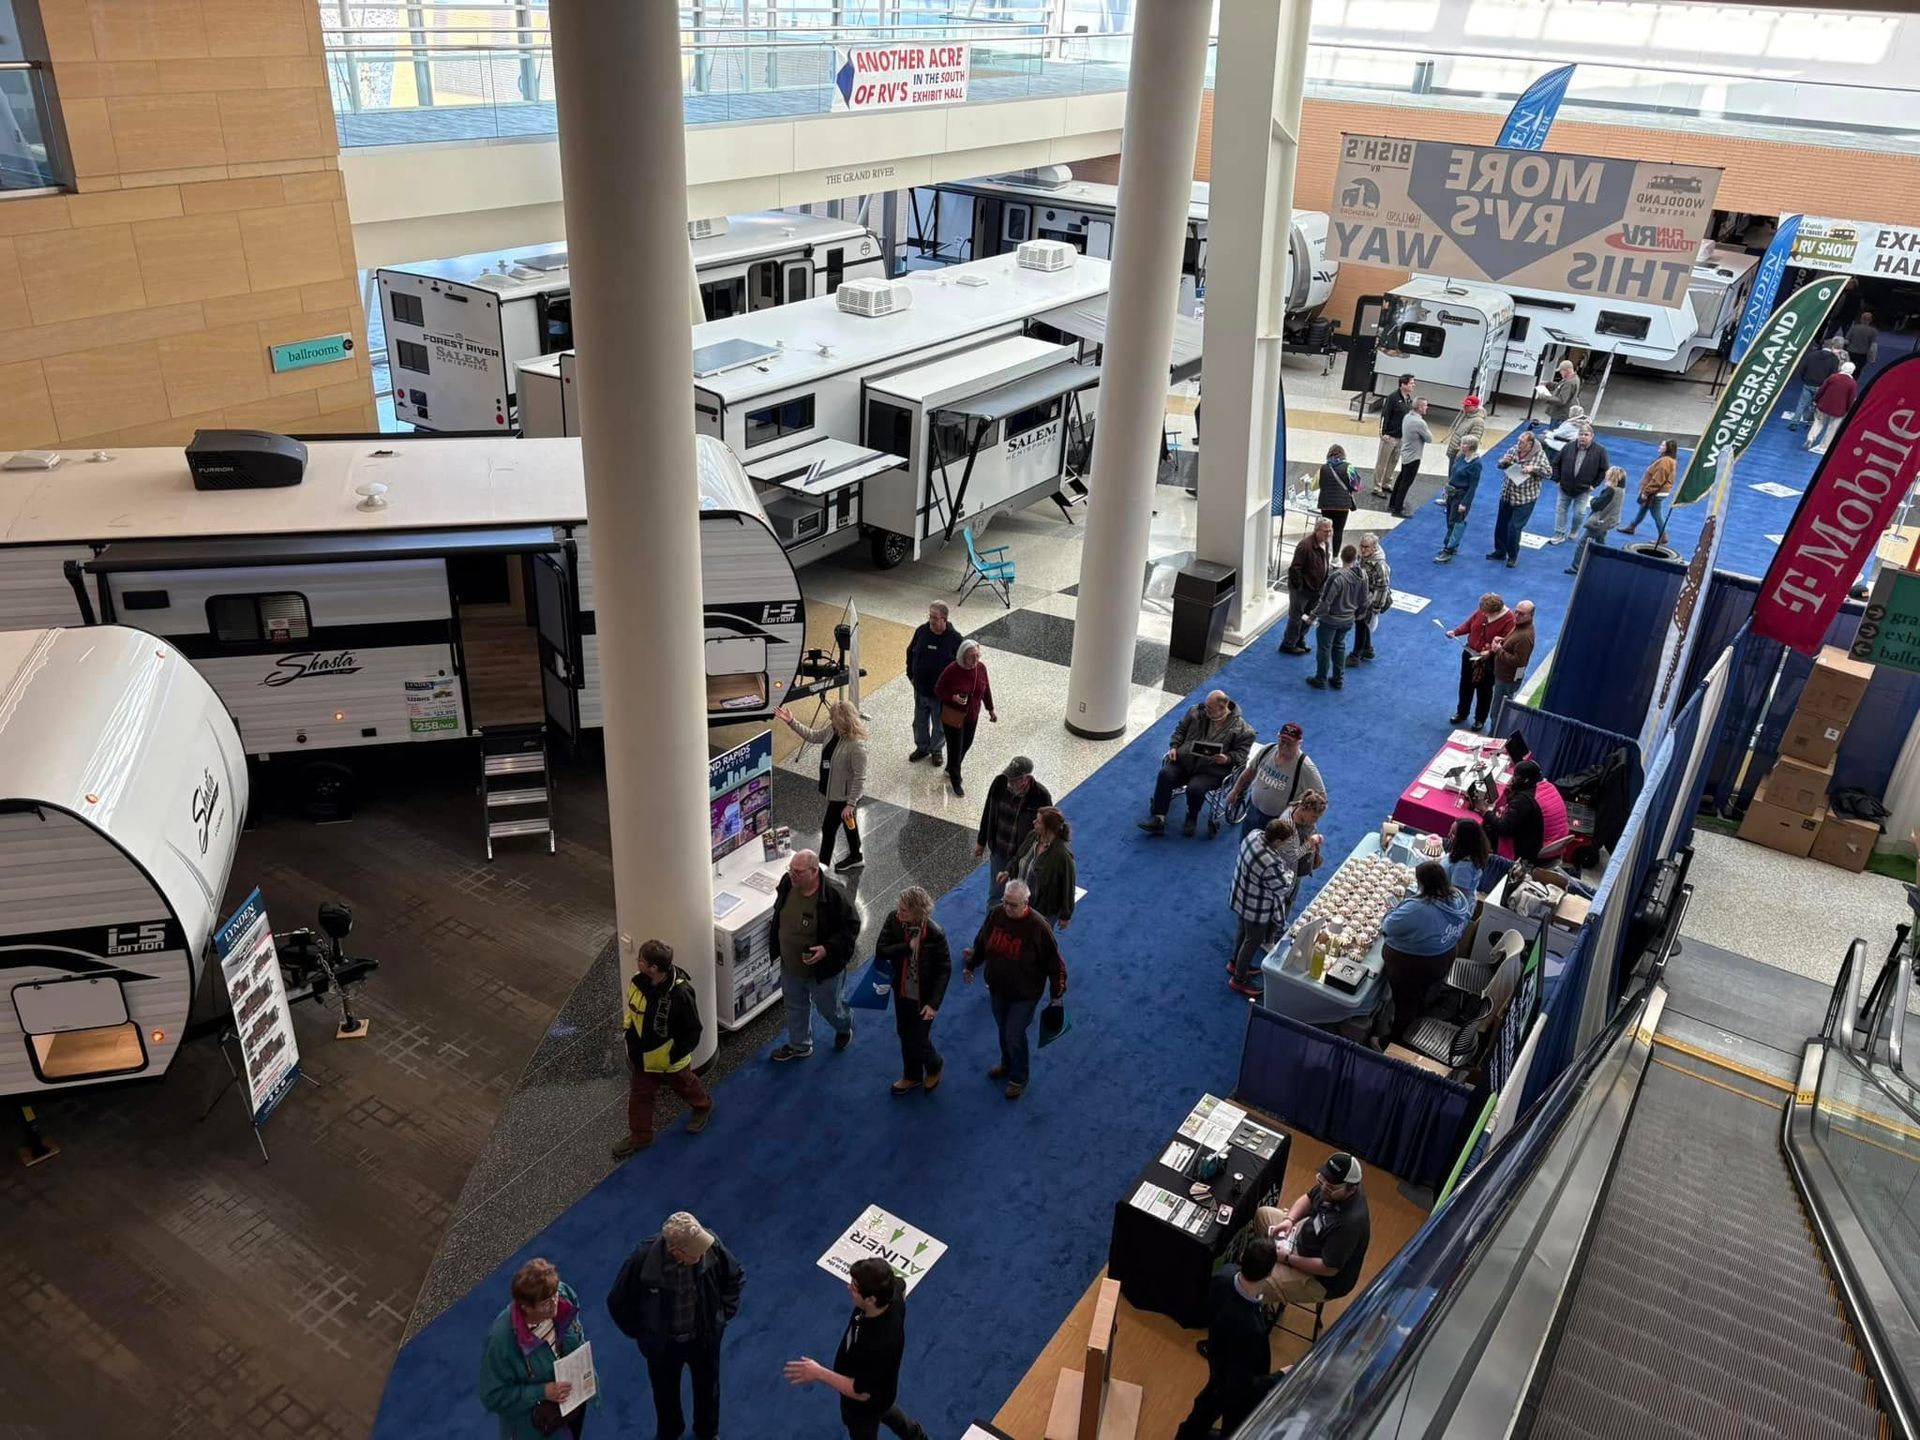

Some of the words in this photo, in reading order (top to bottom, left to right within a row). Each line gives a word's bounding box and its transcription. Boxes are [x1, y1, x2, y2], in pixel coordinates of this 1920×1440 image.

[856, 49, 925, 73] ANOTHER
[929, 47, 963, 68] ACRE
[913, 73, 923, 85] IN
[925, 72, 940, 84] THE
[940, 70, 965, 83] SOUTH
[854, 84, 875, 105] OF
[878, 82, 908, 103] RV'S
[912, 89, 942, 103] EXHIBIT
[944, 87, 963, 99] HALL
[826, 173, 842, 185] THE
[843, 170, 871, 183] GRAND
[872, 167, 895, 178] RIVER
[1799, 240, 1816, 253] RV
[1817, 242, 1855, 258] SHOW
[1740, 252, 1778, 344] LYNDEN
[288, 345, 339, 362] ballrooms
[422, 334, 464, 350] FOREST
[466, 344, 499, 357] RIVER
[436, 346, 488, 366] SALEM
[1703, 311, 1800, 469] WONDERLAND
[1734, 419, 1754, 447] TIRE
[1750, 343, 1799, 415] COMPANY
[1008, 422, 1058, 453] SALEM
[1890, 612, 1920, 626] gra
[1884, 630, 1920, 647] exh
[260, 651, 362, 687] Shasta
[723, 744, 751, 767] RAPIDS
[224, 902, 256, 942] LYNDEN
[108, 942, 165, 955] EDITION
[745, 955, 770, 977] GRAN
[850, 1229, 925, 1276] ALINER
